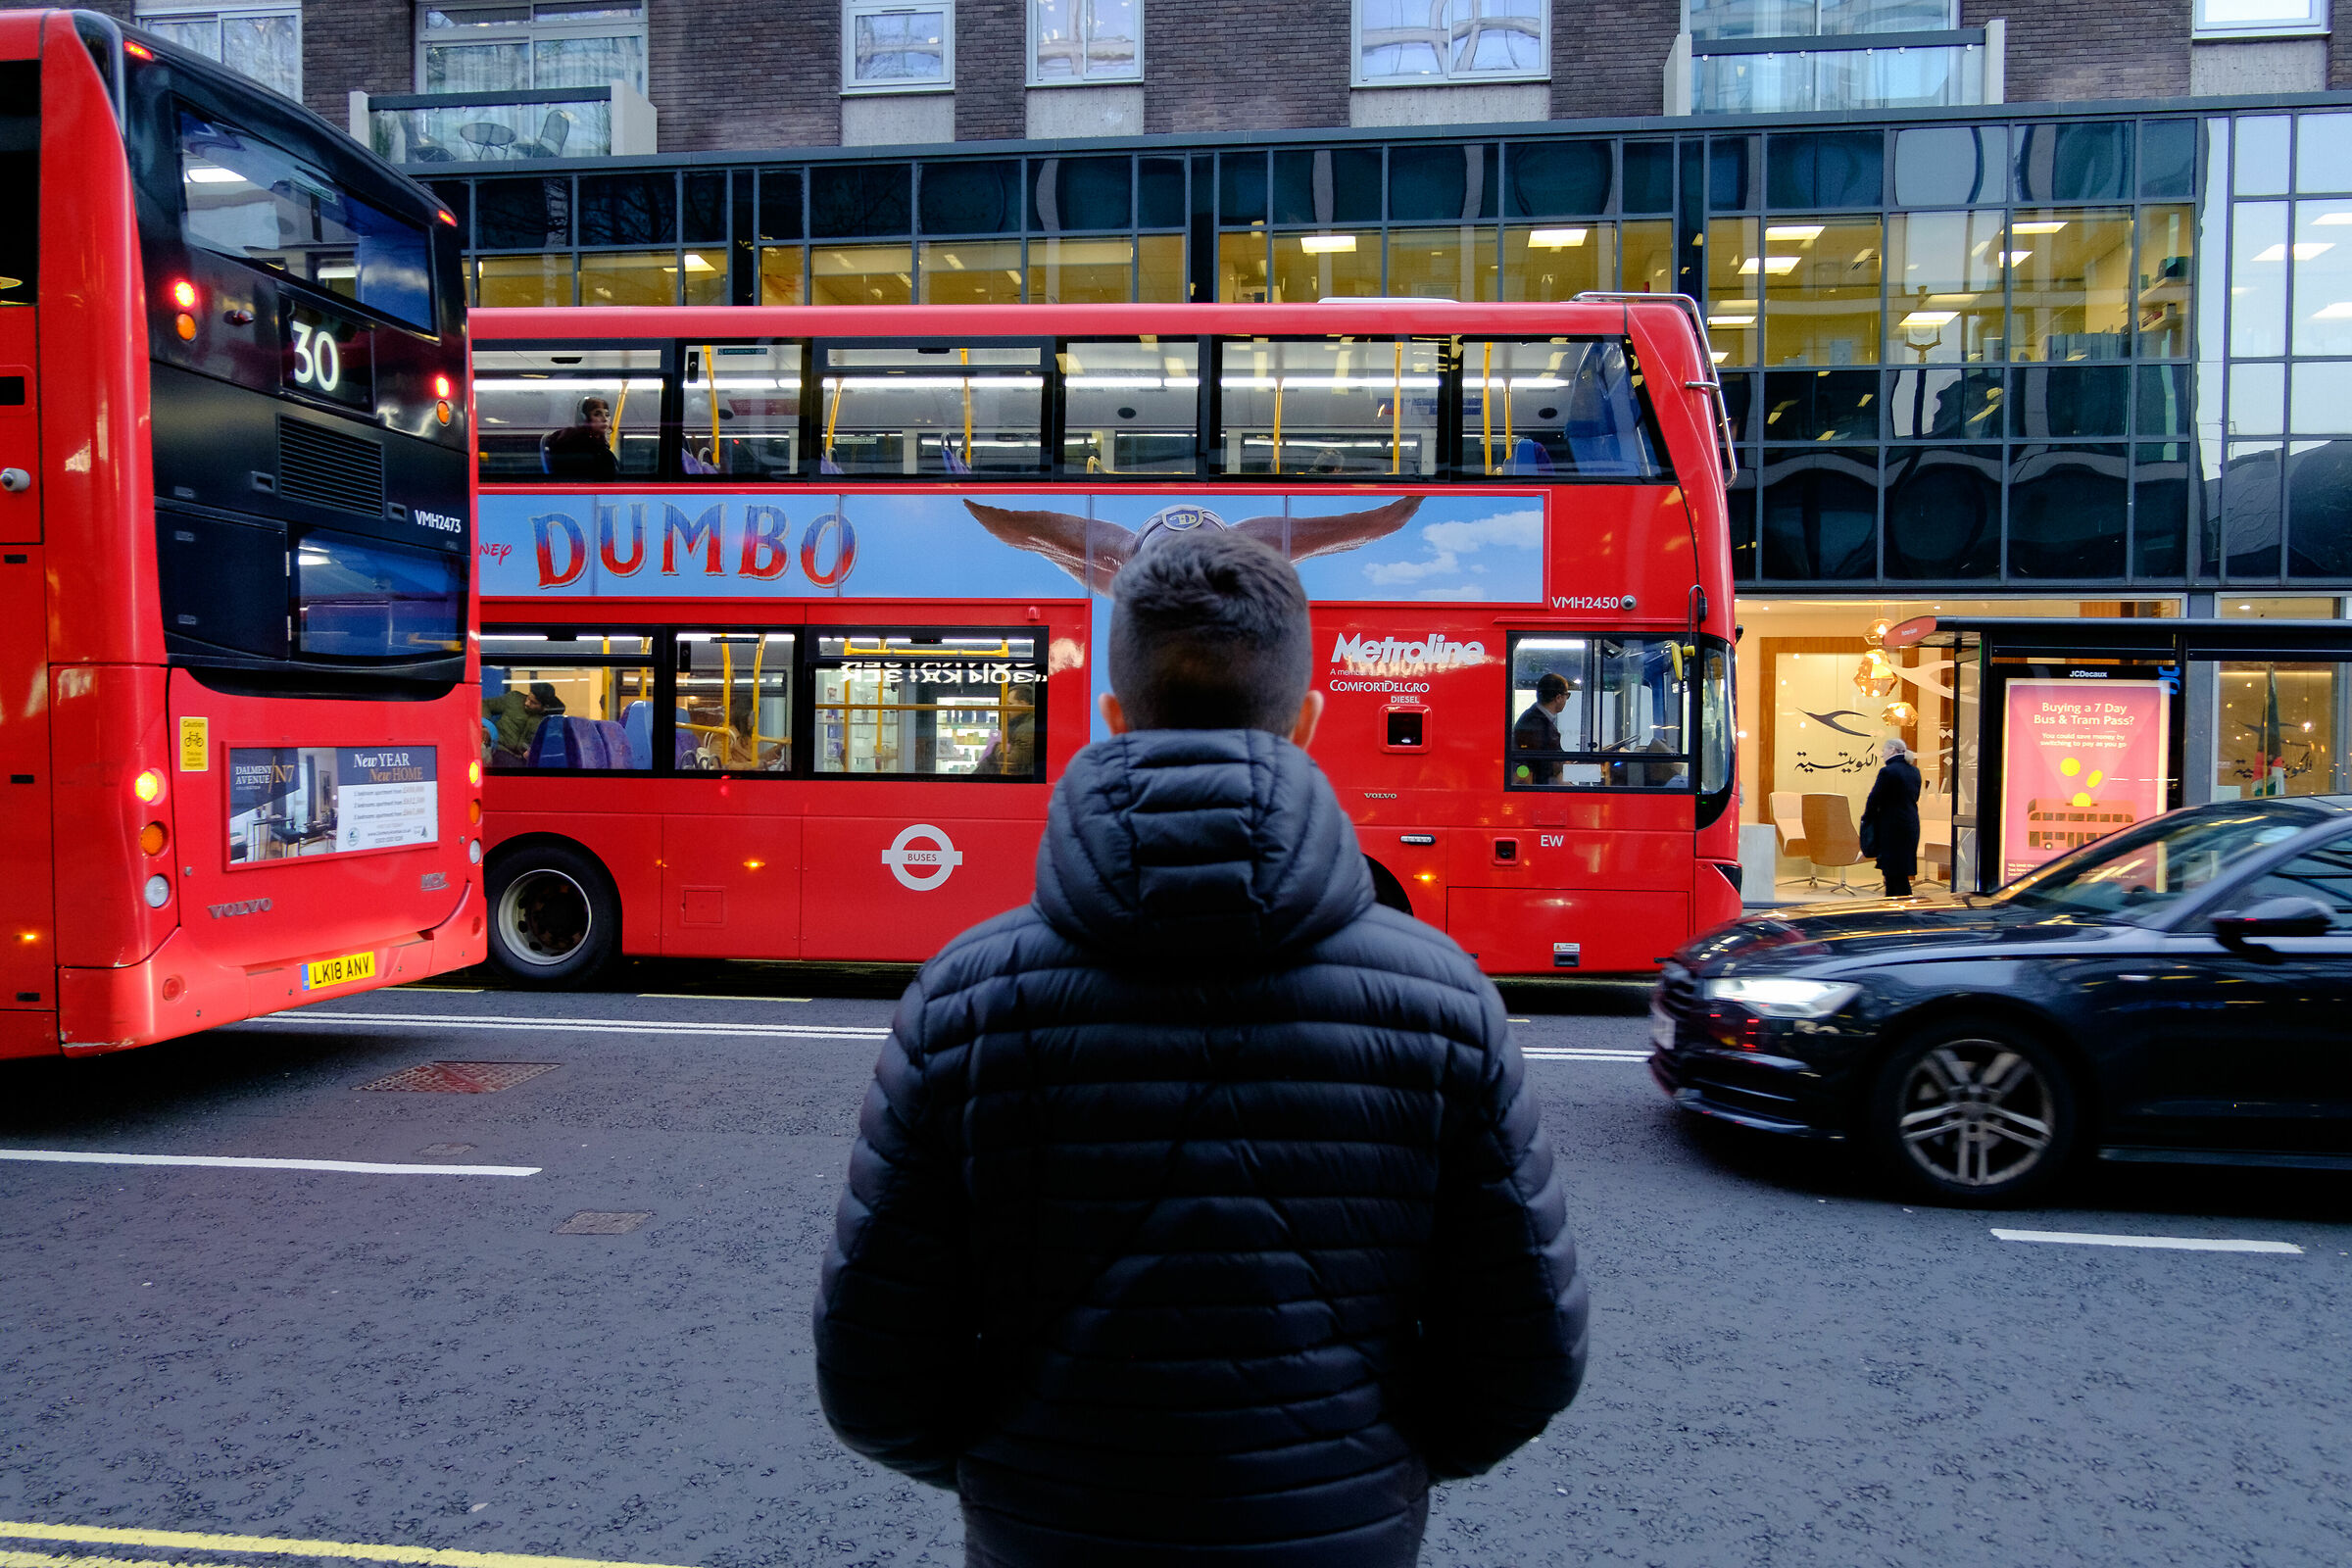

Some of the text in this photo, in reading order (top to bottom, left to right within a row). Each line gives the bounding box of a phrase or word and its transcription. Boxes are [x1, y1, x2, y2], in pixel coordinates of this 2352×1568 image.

[293, 320, 339, 391] 30
[415, 510, 462, 533] VMH2473
[528, 502, 858, 589] DUMBO
[1551, 596, 1619, 609] VMH2450
[1331, 632, 1485, 665] Metroline
[1330, 679, 1430, 693] COMFORTDELGRO
[2041, 702, 2082, 714] Buying
[2094, 703, 2101, 713] 7
[2104, 703, 2128, 714] Day
[2034, 714, 2134, 725] Bus & Tram Pass?
[354, 753, 410, 768] New YEAR
[235, 765, 272, 775] DALMENY
[273, 764, 294, 784] N7
[368, 766, 423, 782] New HOME
[235, 774, 270, 785] AVENUE
[1541, 835, 1564, 847] EW
[907, 853, 937, 862] BUSES
[208, 898, 272, 919] VOLVO
[314, 956, 369, 984] LK18 ANV
